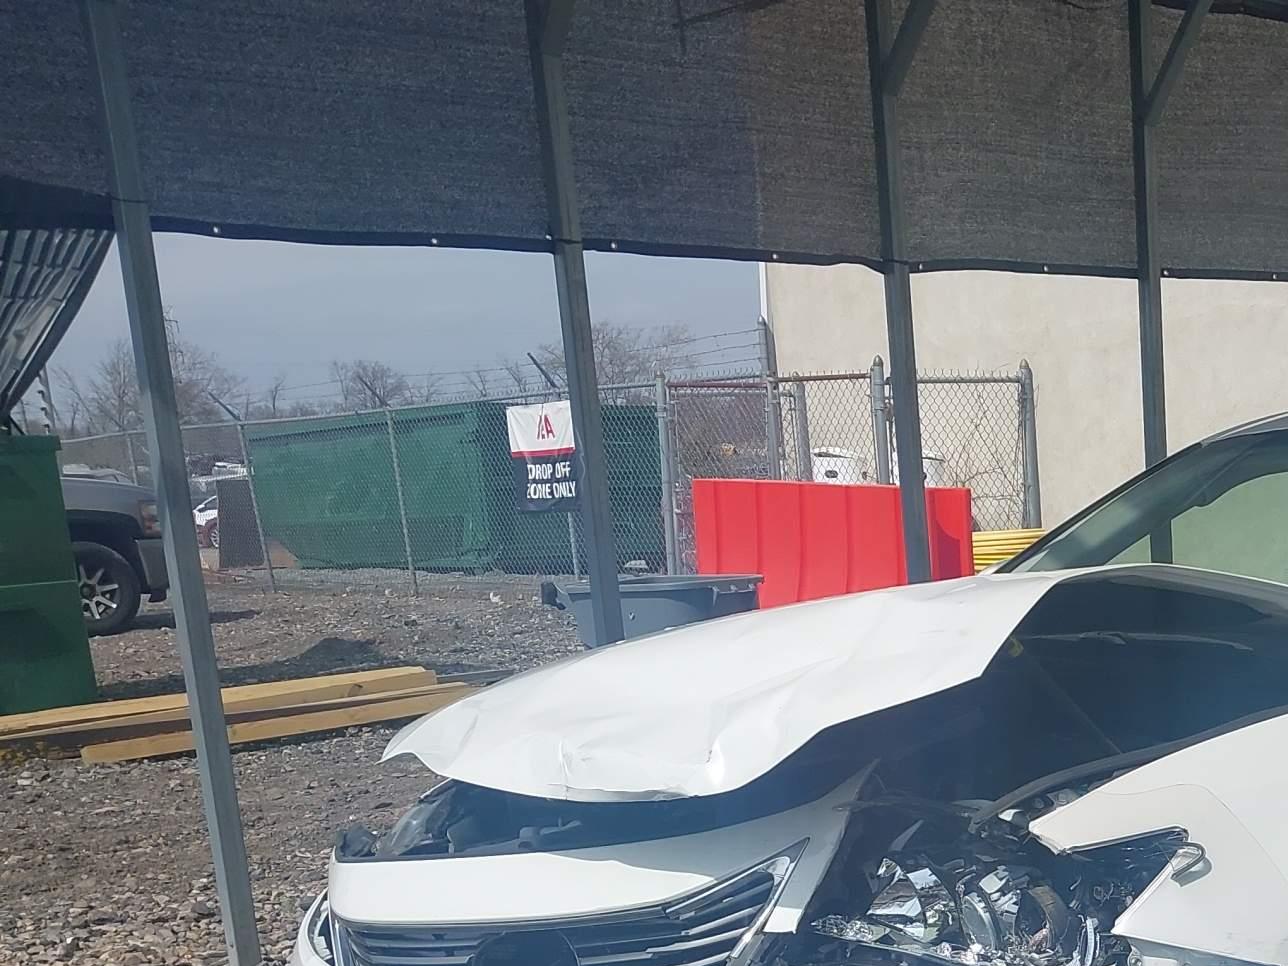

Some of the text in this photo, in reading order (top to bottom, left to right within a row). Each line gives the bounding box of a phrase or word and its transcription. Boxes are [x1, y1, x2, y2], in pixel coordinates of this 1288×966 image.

[527, 461, 571, 480] DROP OFF
[553, 480, 576, 498] ONLY
